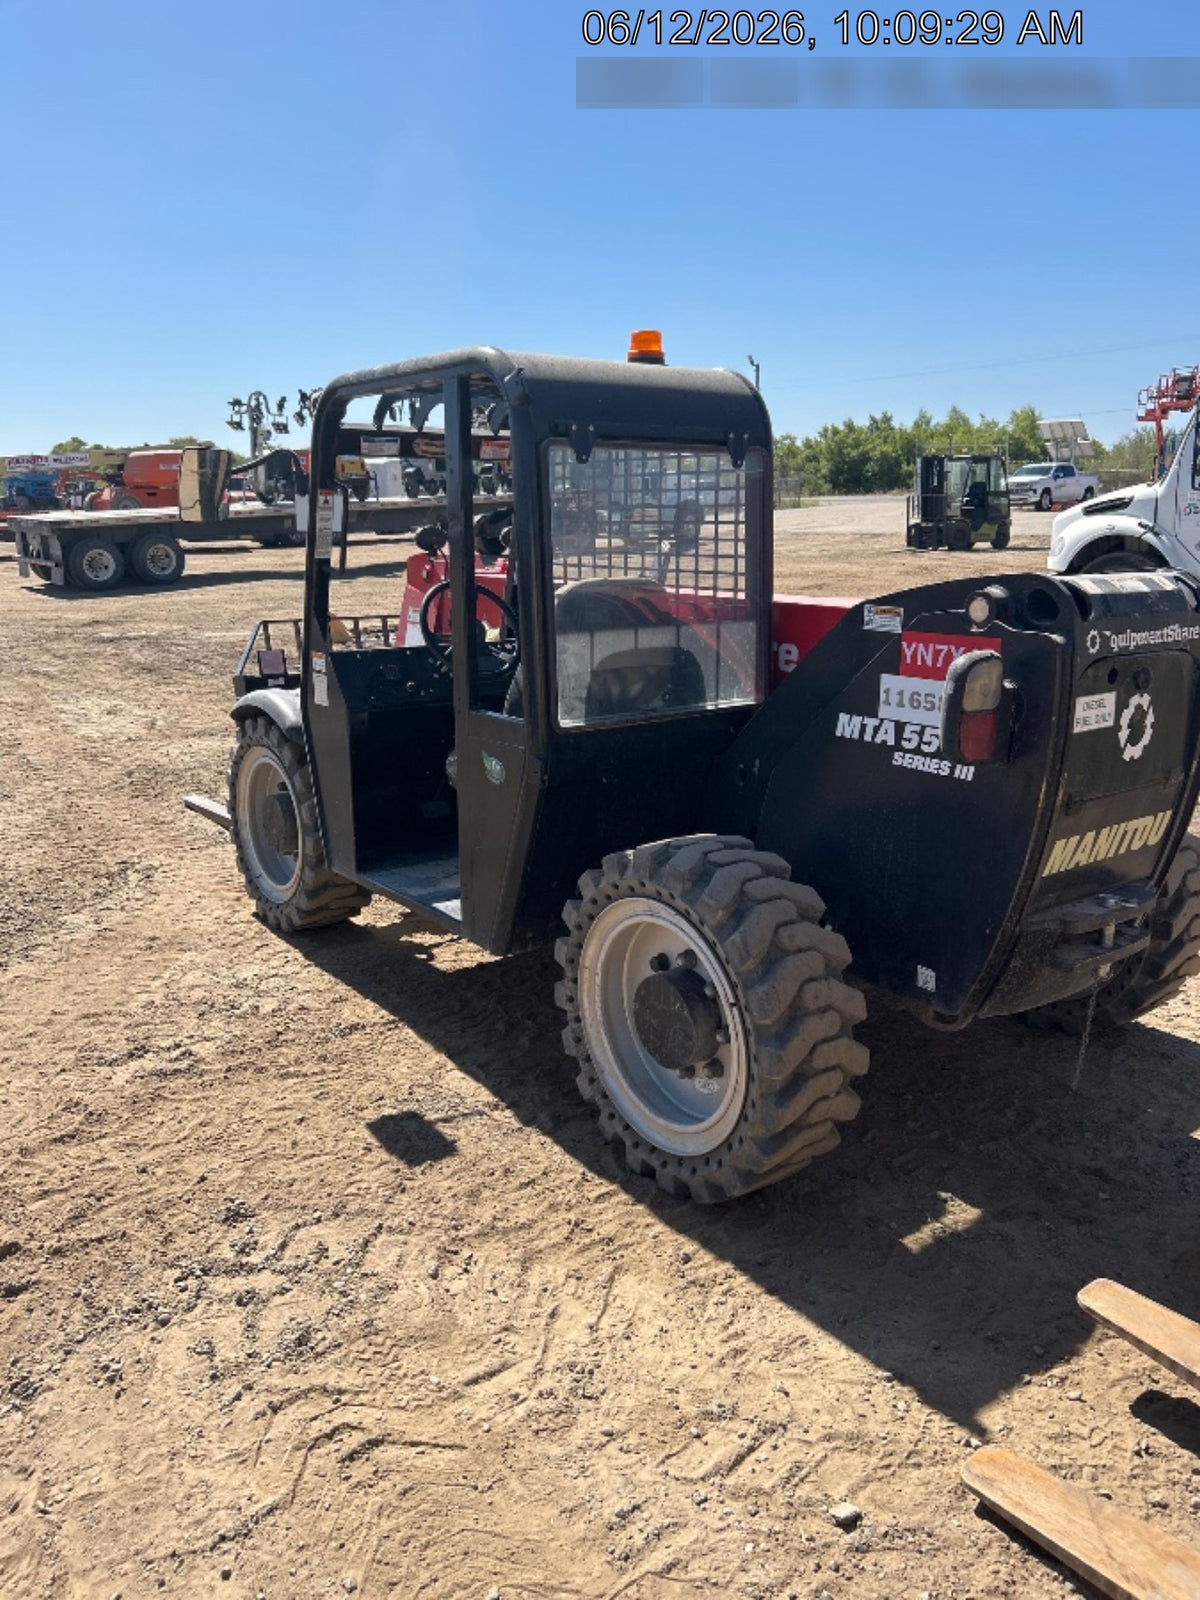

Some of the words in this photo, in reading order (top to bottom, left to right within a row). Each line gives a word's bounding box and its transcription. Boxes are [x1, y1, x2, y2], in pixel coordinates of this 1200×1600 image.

[1102, 624, 1200, 652] quipmentShare
[881, 687, 942, 712] 1165
[1082, 698, 1107, 712] DIESEL
[835, 712, 896, 746] MTA
[892, 751, 952, 776] SERIES
[953, 764, 976, 782] III
[1042, 808, 1173, 878] MANITOU
